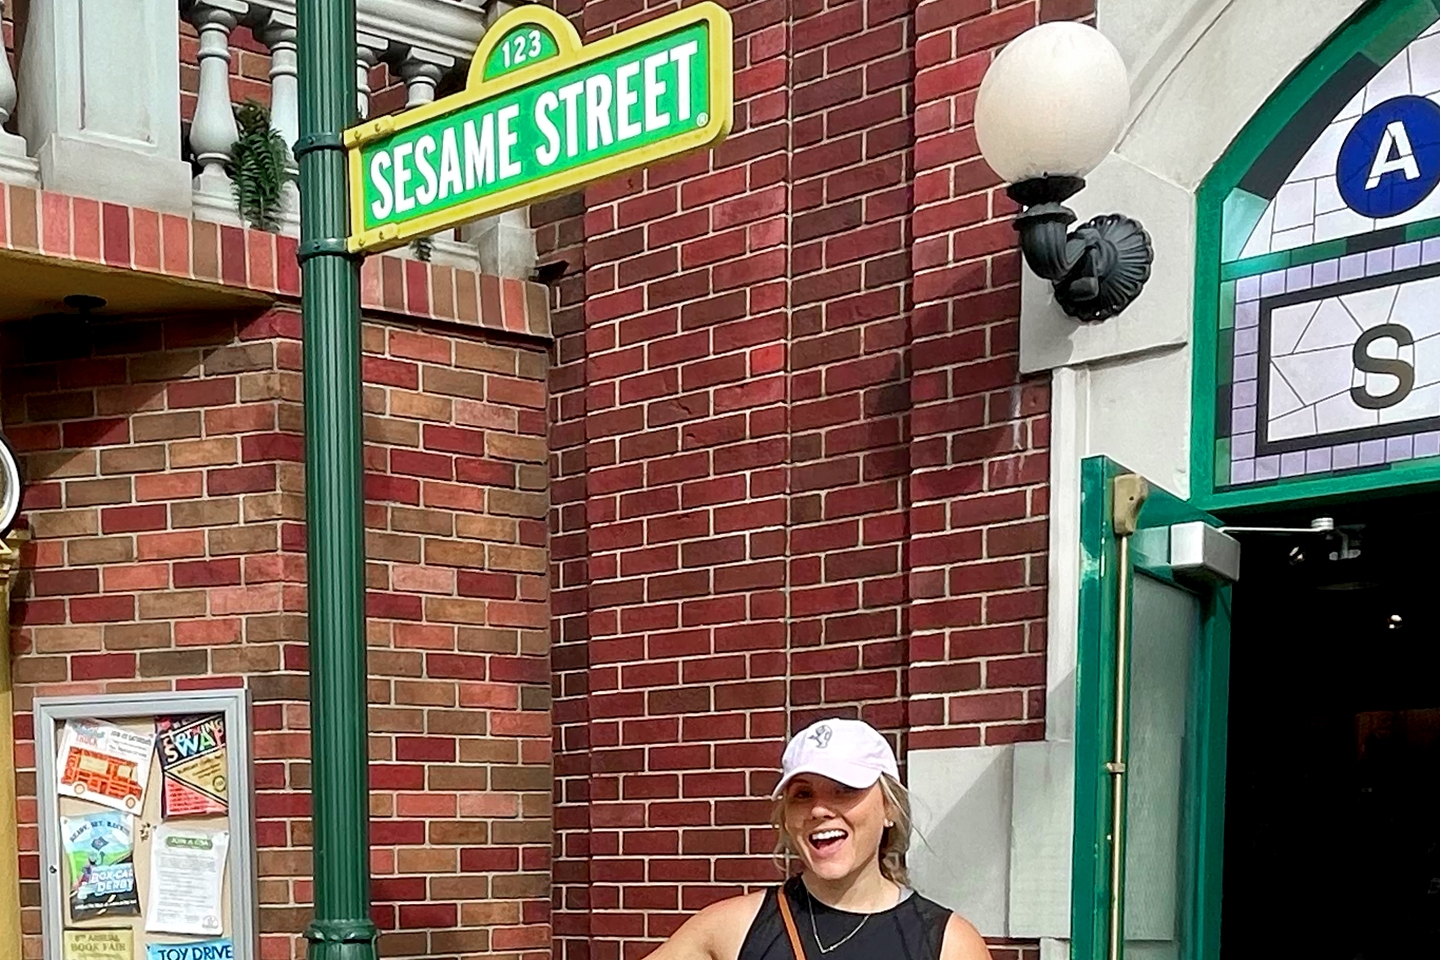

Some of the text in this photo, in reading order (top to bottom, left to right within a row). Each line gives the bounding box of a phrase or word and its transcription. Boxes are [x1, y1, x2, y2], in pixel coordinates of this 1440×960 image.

[501, 29, 543, 69] 123
[369, 39, 699, 221] SESAME STREET
[1364, 119, 1421, 191] A
[1351, 322, 1416, 410] S
[164, 728, 224, 763] SWAP
[96, 880, 133, 893] DERBY
[70, 943, 126, 952] BOOK FAIR
[191, 944, 234, 960] DRIVE
